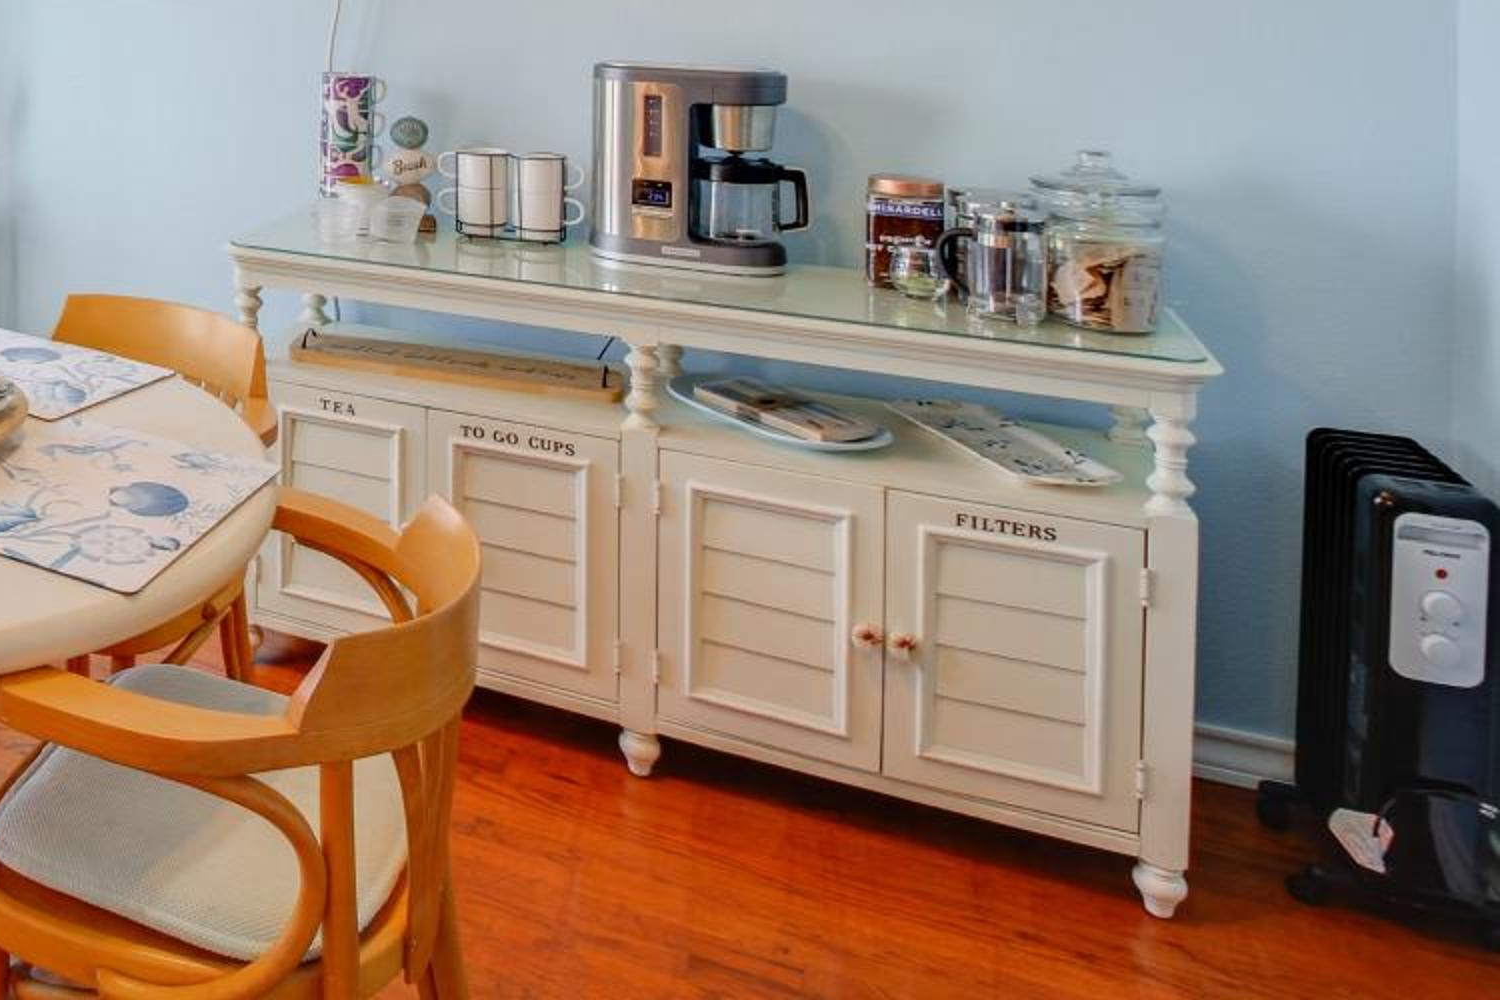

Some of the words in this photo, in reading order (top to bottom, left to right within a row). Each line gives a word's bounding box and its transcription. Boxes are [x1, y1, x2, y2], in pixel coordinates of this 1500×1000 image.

[319, 398, 357, 417] TEA
[459, 424, 485, 440] TO
[492, 429, 519, 446] GO
[528, 436, 577, 457] CUPS
[955, 512, 1058, 541] FILTERS
